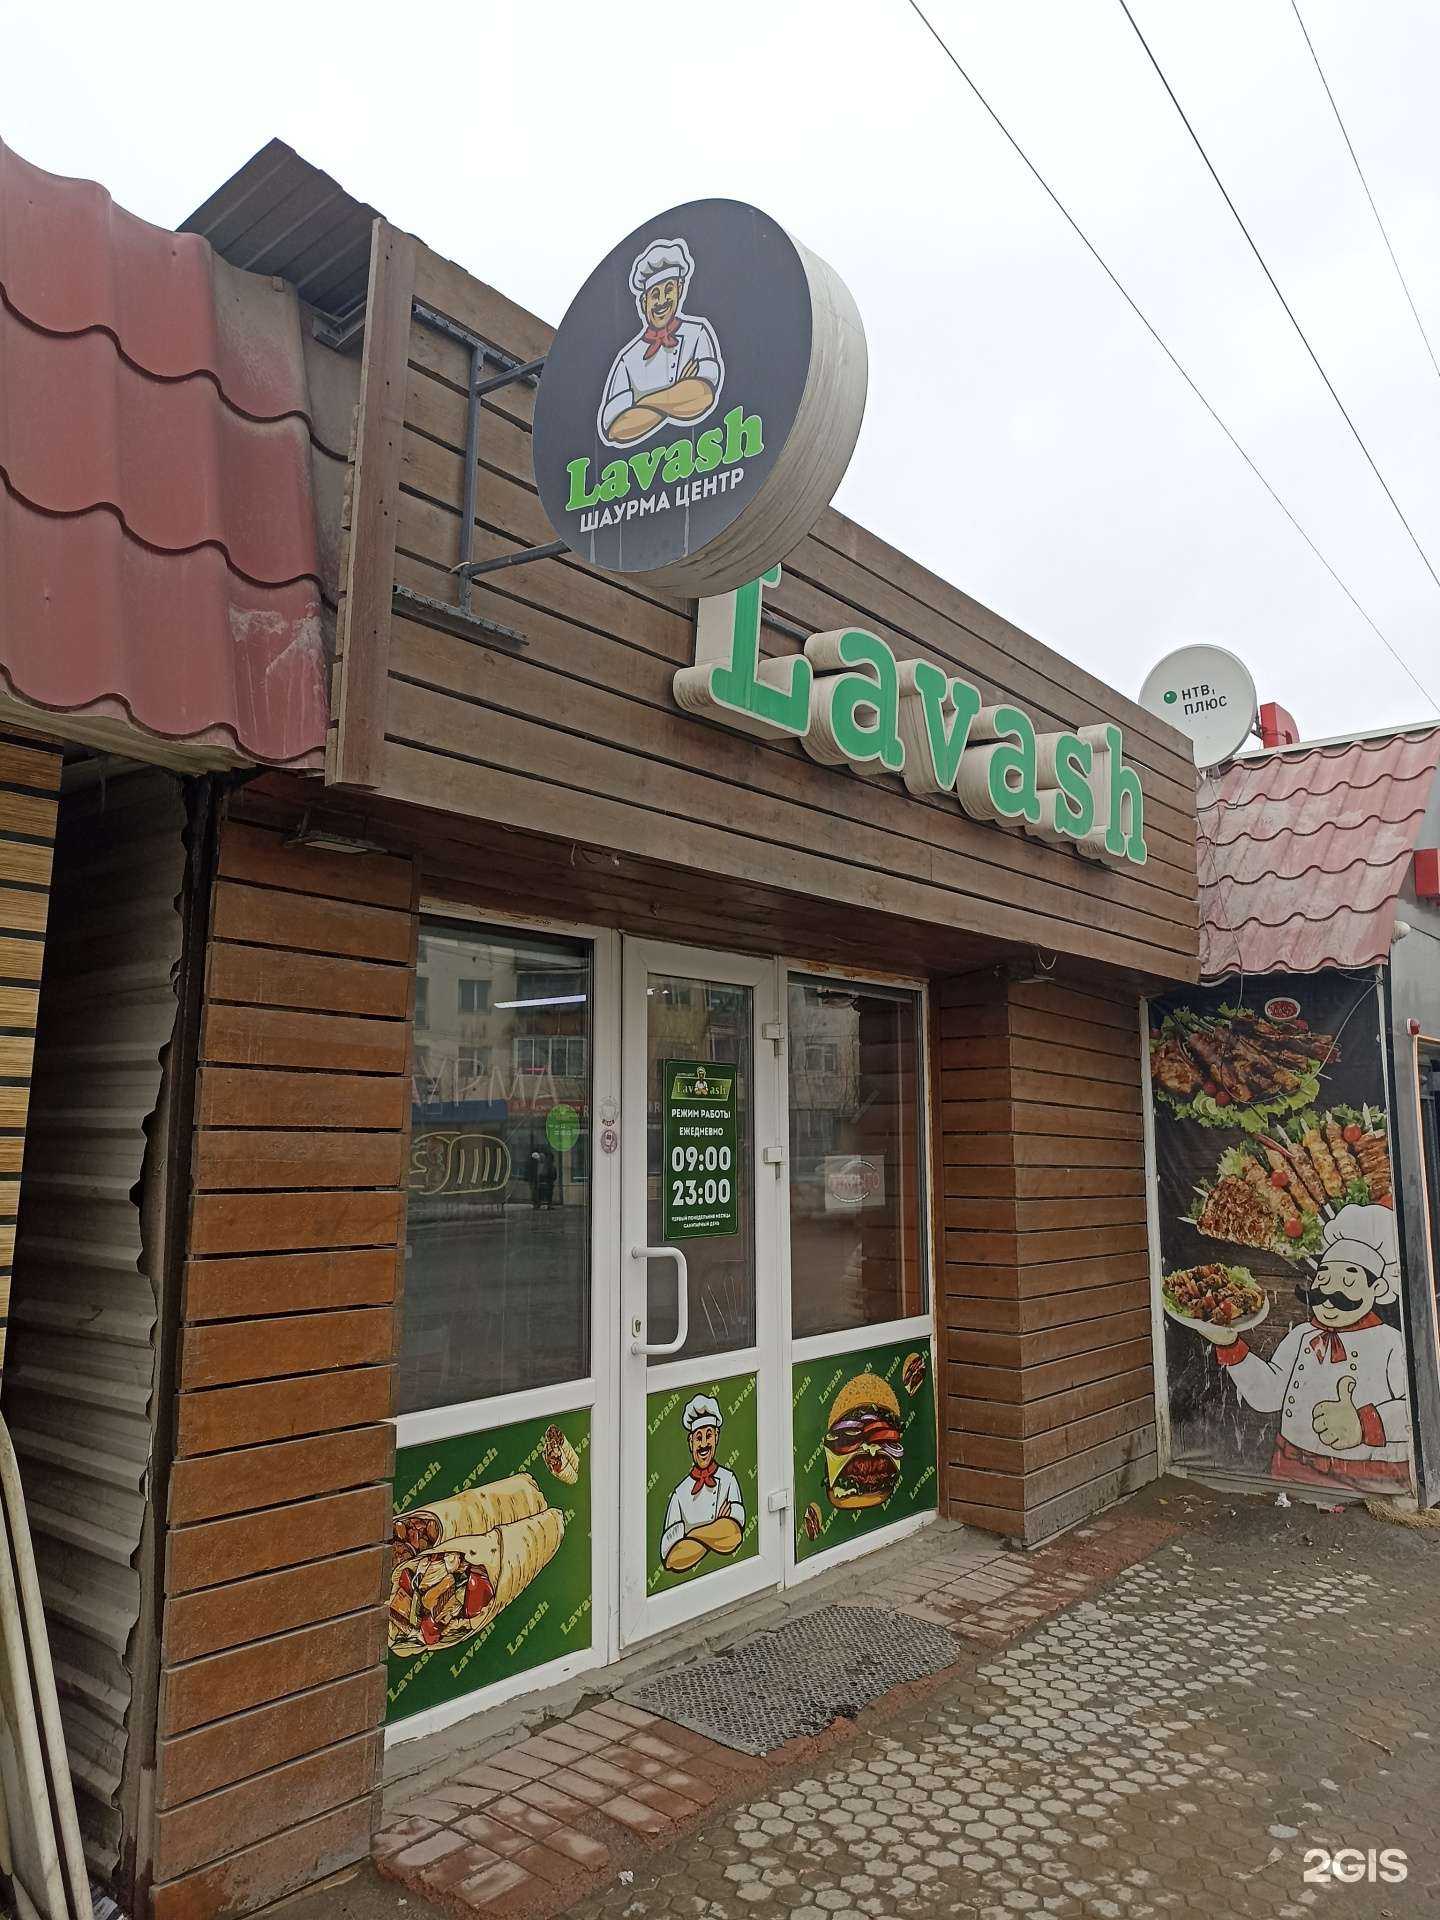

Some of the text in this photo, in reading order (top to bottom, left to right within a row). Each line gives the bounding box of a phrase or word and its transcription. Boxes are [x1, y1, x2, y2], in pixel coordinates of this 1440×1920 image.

[566, 406, 764, 511] Lavash
[580, 468, 744, 532] ШАУРМА ЦЕНТР
[706, 563, 1147, 866] Lavash
[1184, 695, 1228, 716] ПЛЮС
[411, 1056, 560, 1109] УРМА
[671, 1108, 731, 1119] РЕЖИМ РАБОТЫ
[679, 1126, 724, 1138] ЕЖЕДНЕВНО
[671, 1146, 731, 1172] 09:00
[672, 1178, 731, 1206] 23:00
[648, 1393, 681, 1436] Lavash
[392, 1461, 442, 1514] Lavash
[505, 1600, 550, 1656] Lavash
